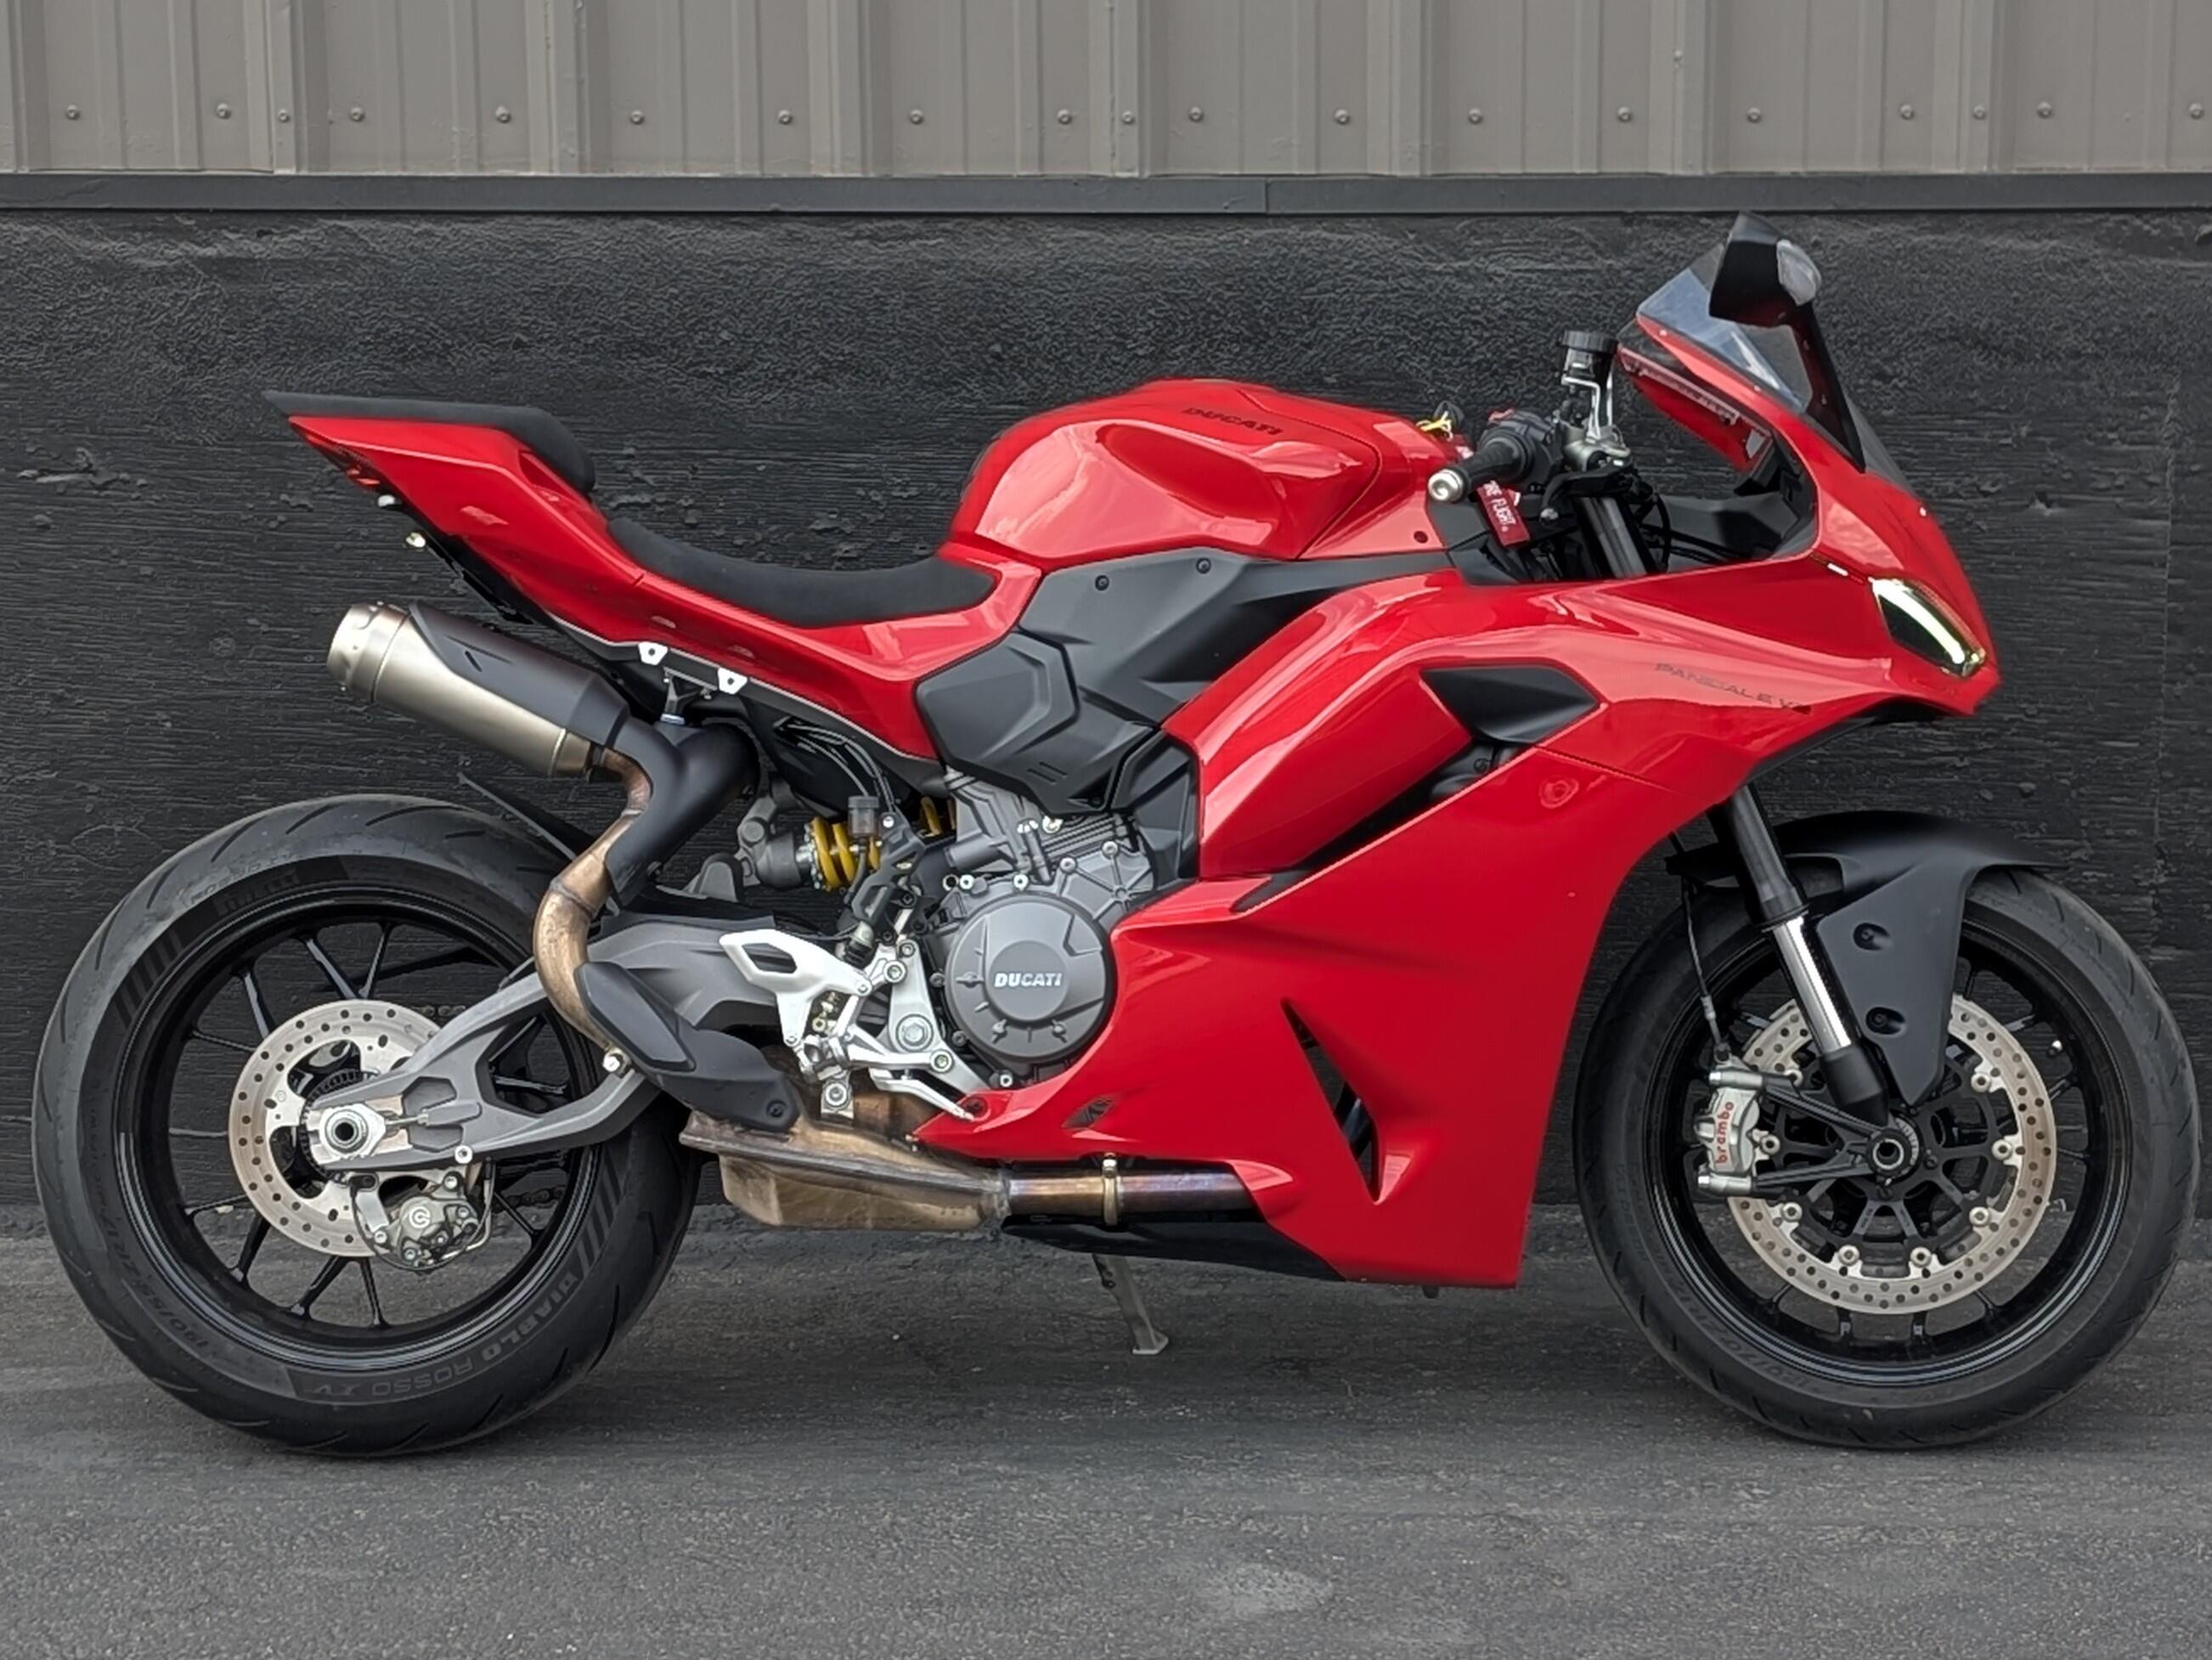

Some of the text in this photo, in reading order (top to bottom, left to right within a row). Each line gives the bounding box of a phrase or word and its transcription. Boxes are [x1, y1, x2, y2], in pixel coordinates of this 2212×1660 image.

[1182, 407, 1284, 435] DUCATI
[994, 973, 1063, 987] DUCATI
[1716, 1102, 1735, 1164] brembo
[480, 1272, 581, 1362] DIABLO
[370, 1357, 475, 1396] ROSSO
